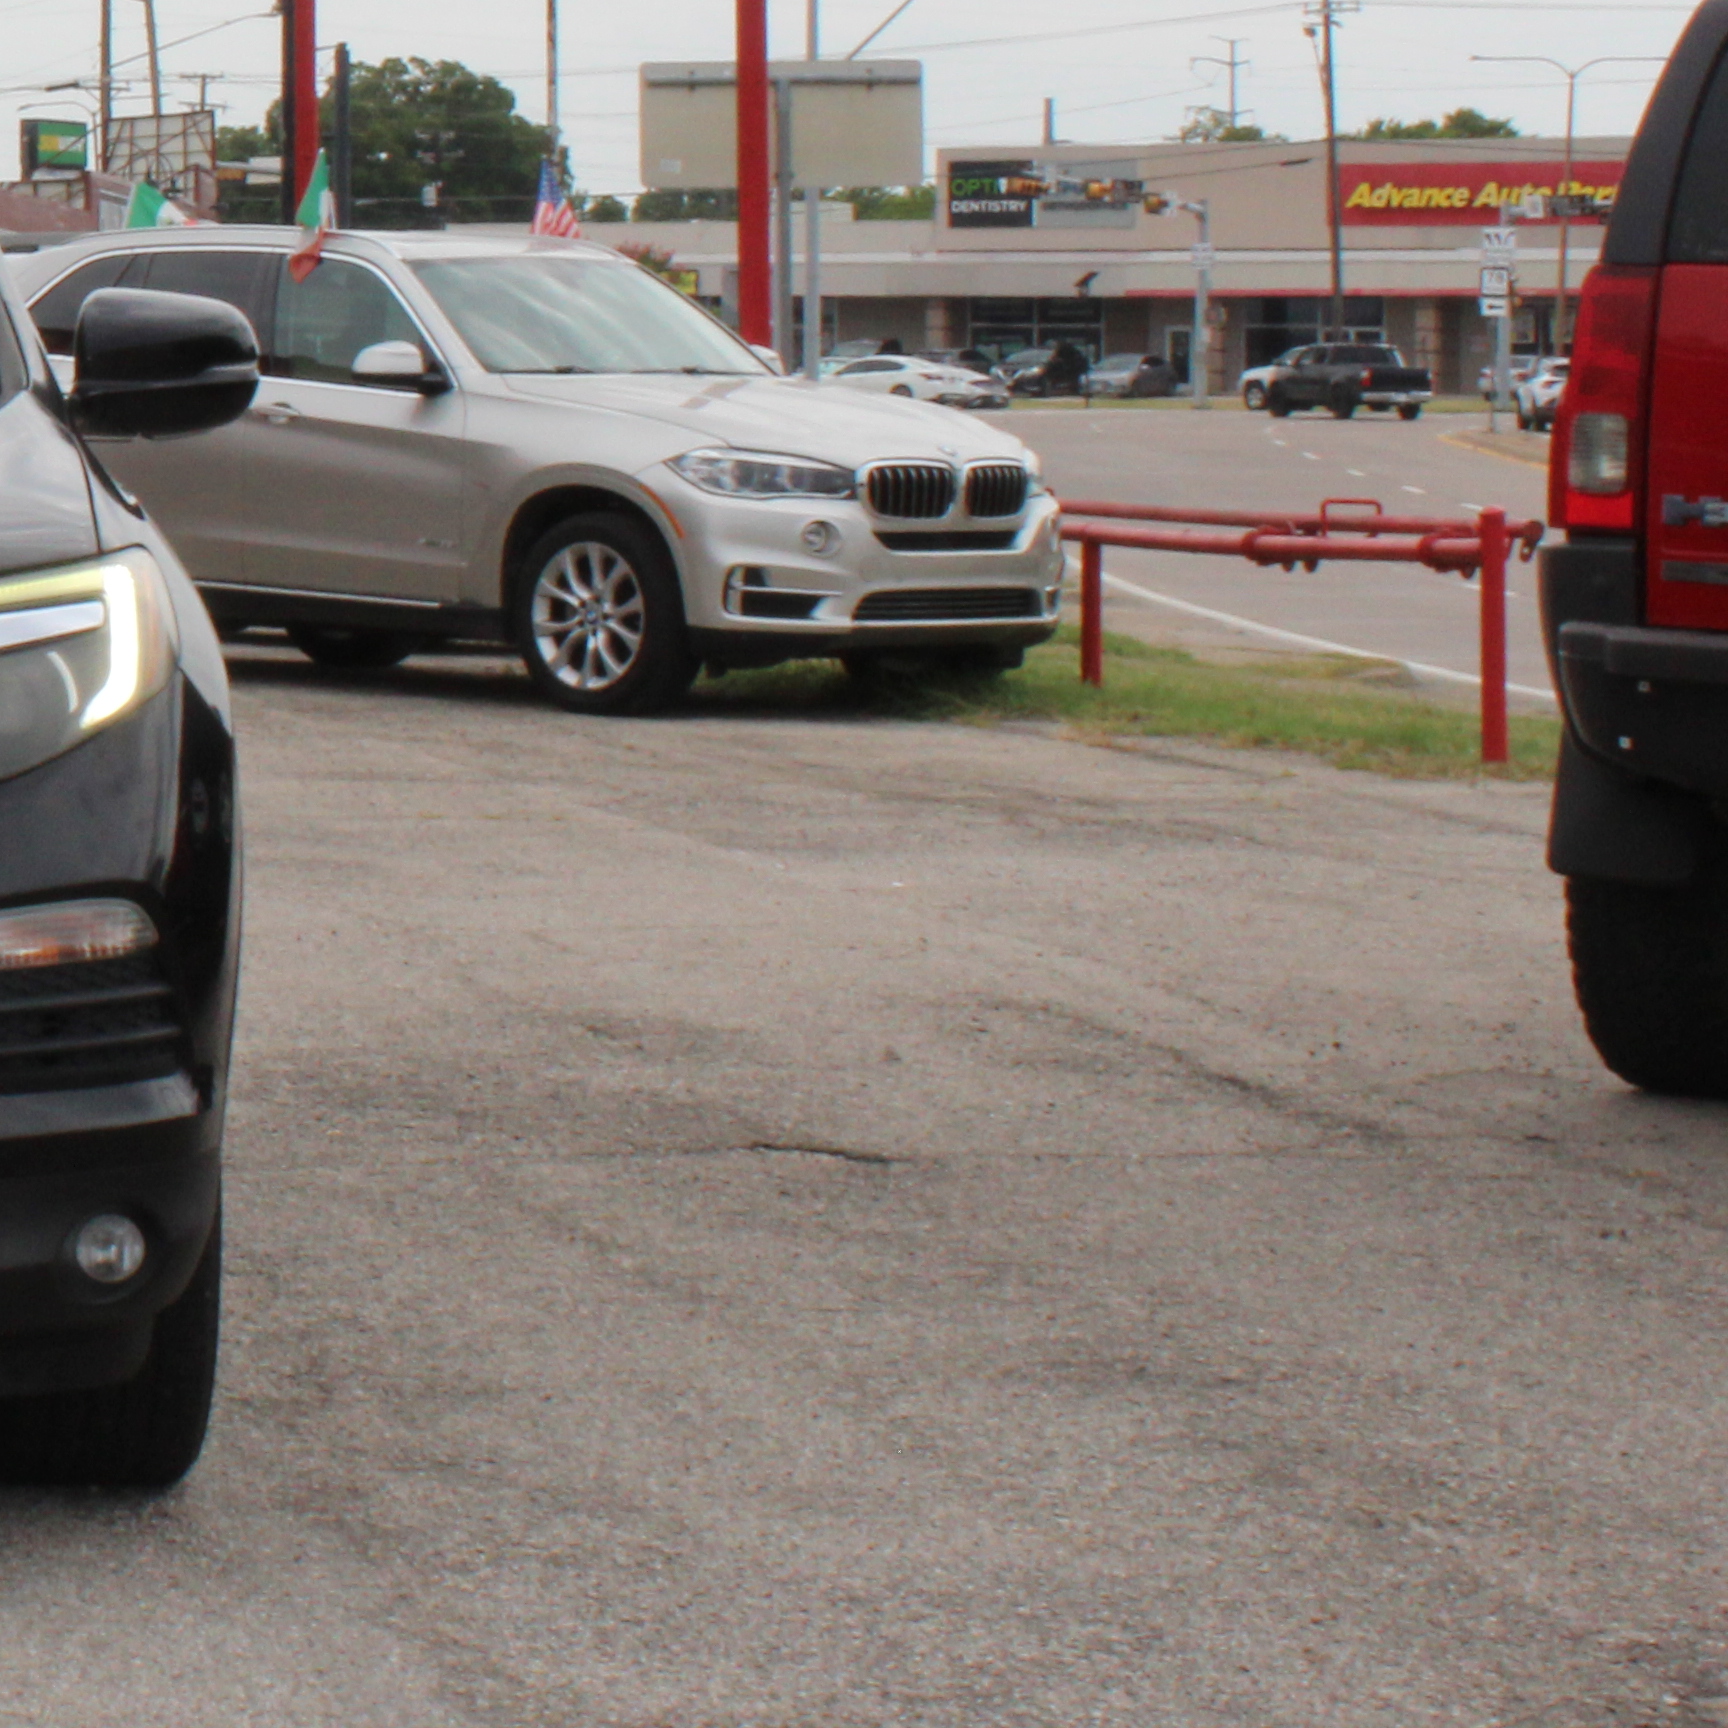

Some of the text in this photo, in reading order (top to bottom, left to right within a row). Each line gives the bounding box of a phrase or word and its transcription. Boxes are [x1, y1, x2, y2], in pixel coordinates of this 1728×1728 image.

[951, 177, 1000, 197] OPTI
[1345, 181, 1471, 209] Advance
[951, 199, 1029, 213] DENTISTRY
